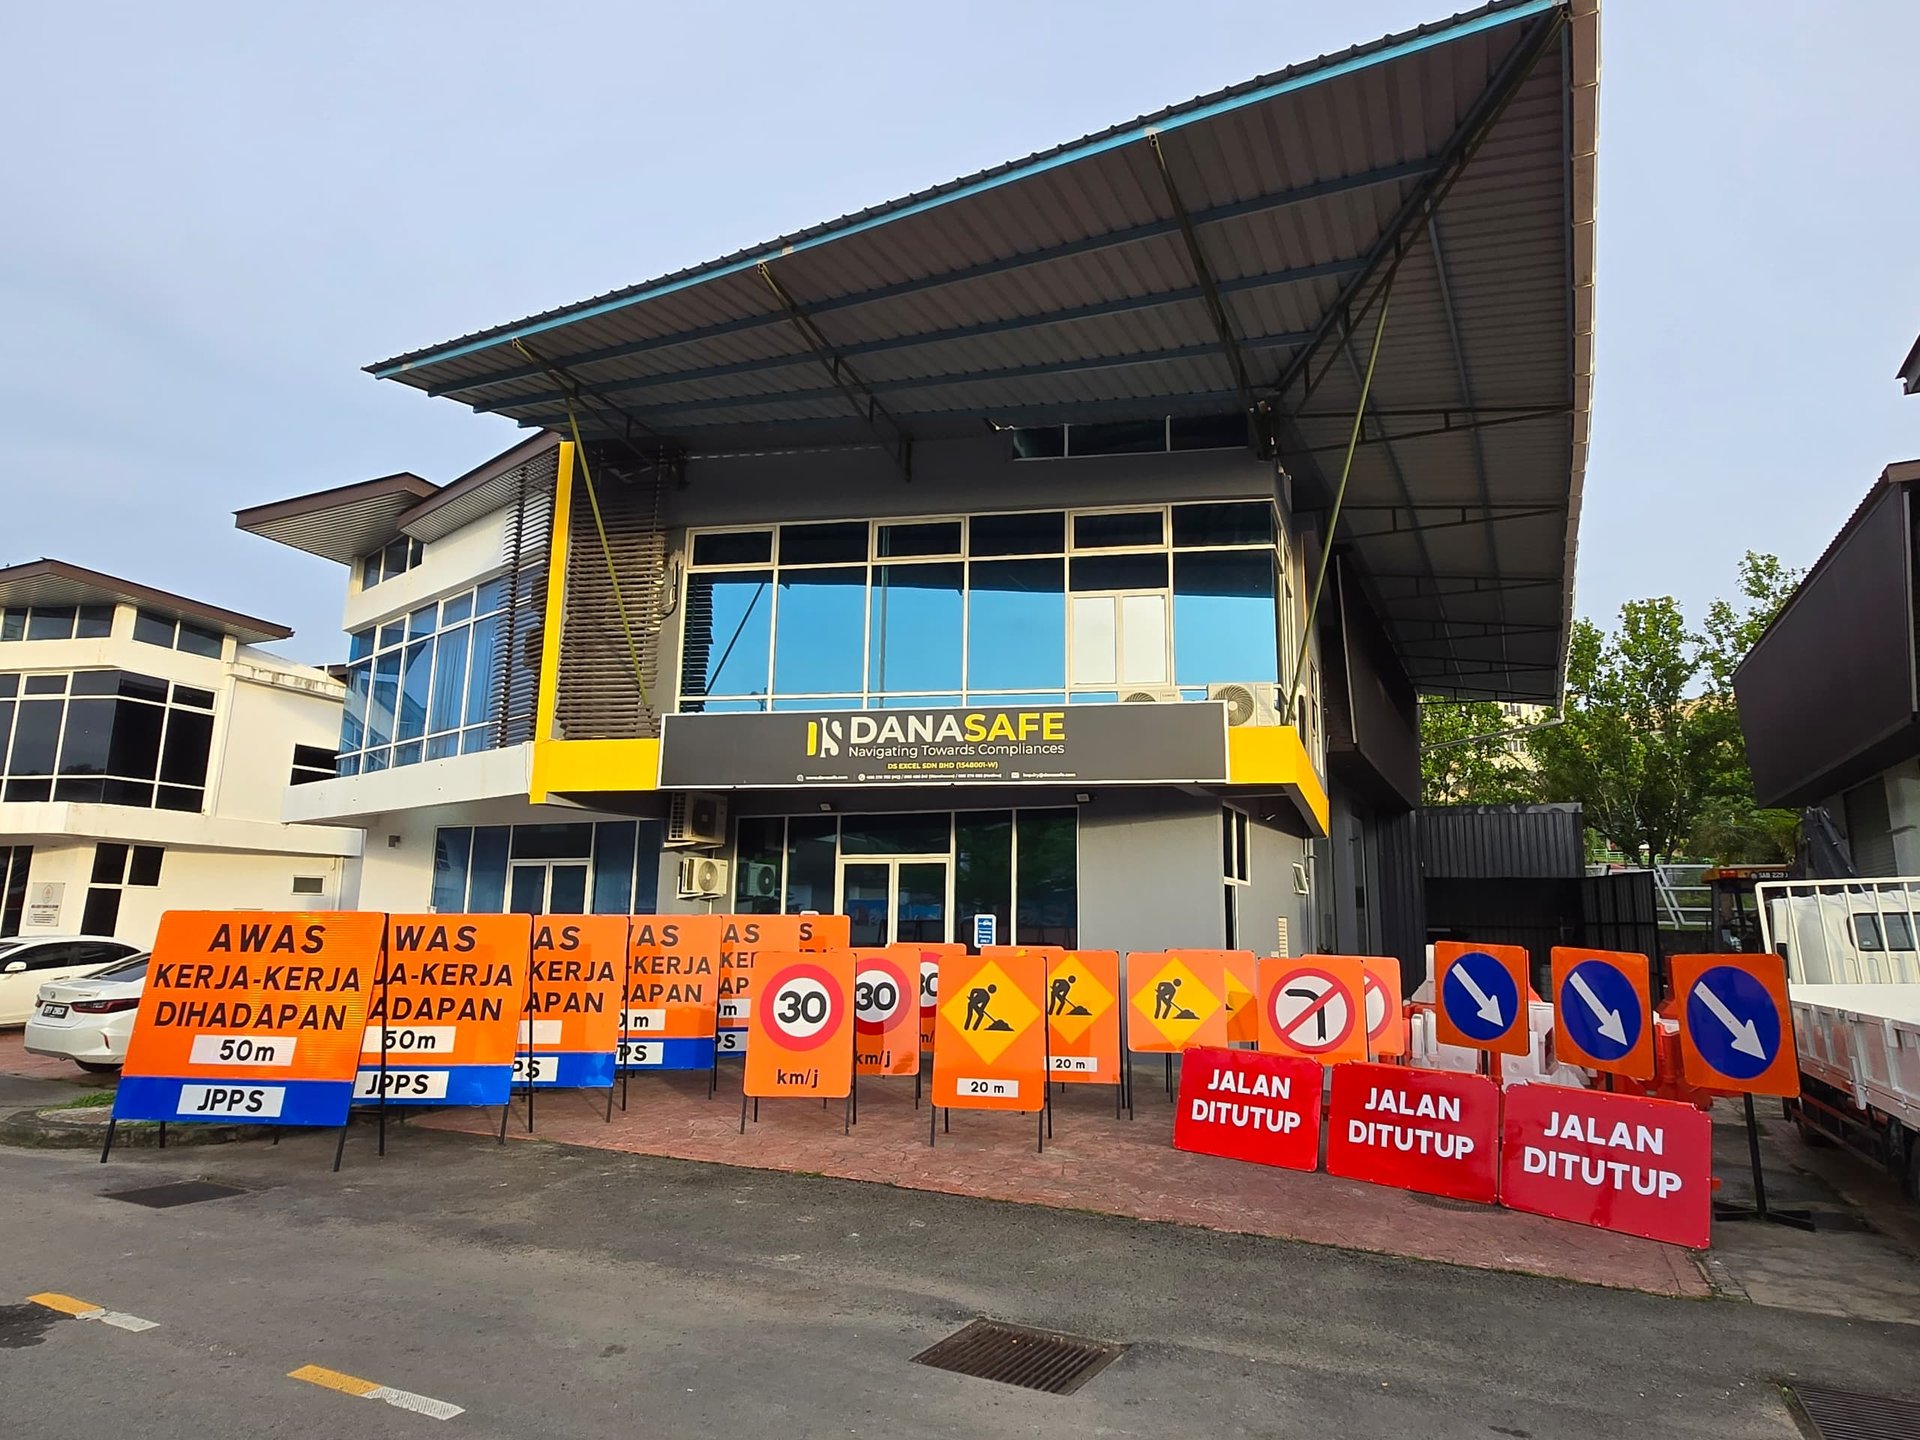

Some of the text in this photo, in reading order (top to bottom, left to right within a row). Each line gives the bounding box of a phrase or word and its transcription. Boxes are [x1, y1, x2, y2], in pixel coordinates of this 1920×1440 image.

[850, 712, 1066, 744] DANASAFE
[848, 742, 1065, 760] Navigating Towards Compliances
[898, 762, 921, 770] EXCEL
[208, 924, 326, 953] AWAS
[381, 925, 477, 951] WAS
[629, 925, 679, 947] AS
[153, 964, 360, 991] KERJA-KERJA
[528, 961, 614, 981] KERJA
[778, 990, 827, 1023] 30
[856, 982, 897, 1011] 30
[154, 1001, 347, 1030] DIHADAPAN
[219, 1039, 275, 1061] 50m
[384, 1030, 436, 1050] 50m
[617, 1045, 647, 1062] PS
[856, 1050, 891, 1068] km/j
[1055, 1059, 1085, 1069] 20 m
[365, 1074, 429, 1095] JPPS
[777, 1069, 819, 1088] km/j
[970, 1081, 1004, 1094] 20 m
[1207, 1068, 1291, 1100] JALAN
[197, 1088, 264, 1112] JPPS
[1364, 1087, 1461, 1122] JALAN
[1191, 1099, 1301, 1134] DITUTUP
[1348, 1119, 1475, 1160] DITUTUP
[1543, 1111, 1664, 1156] JALAN
[1523, 1146, 1682, 1199] DITUTUP
